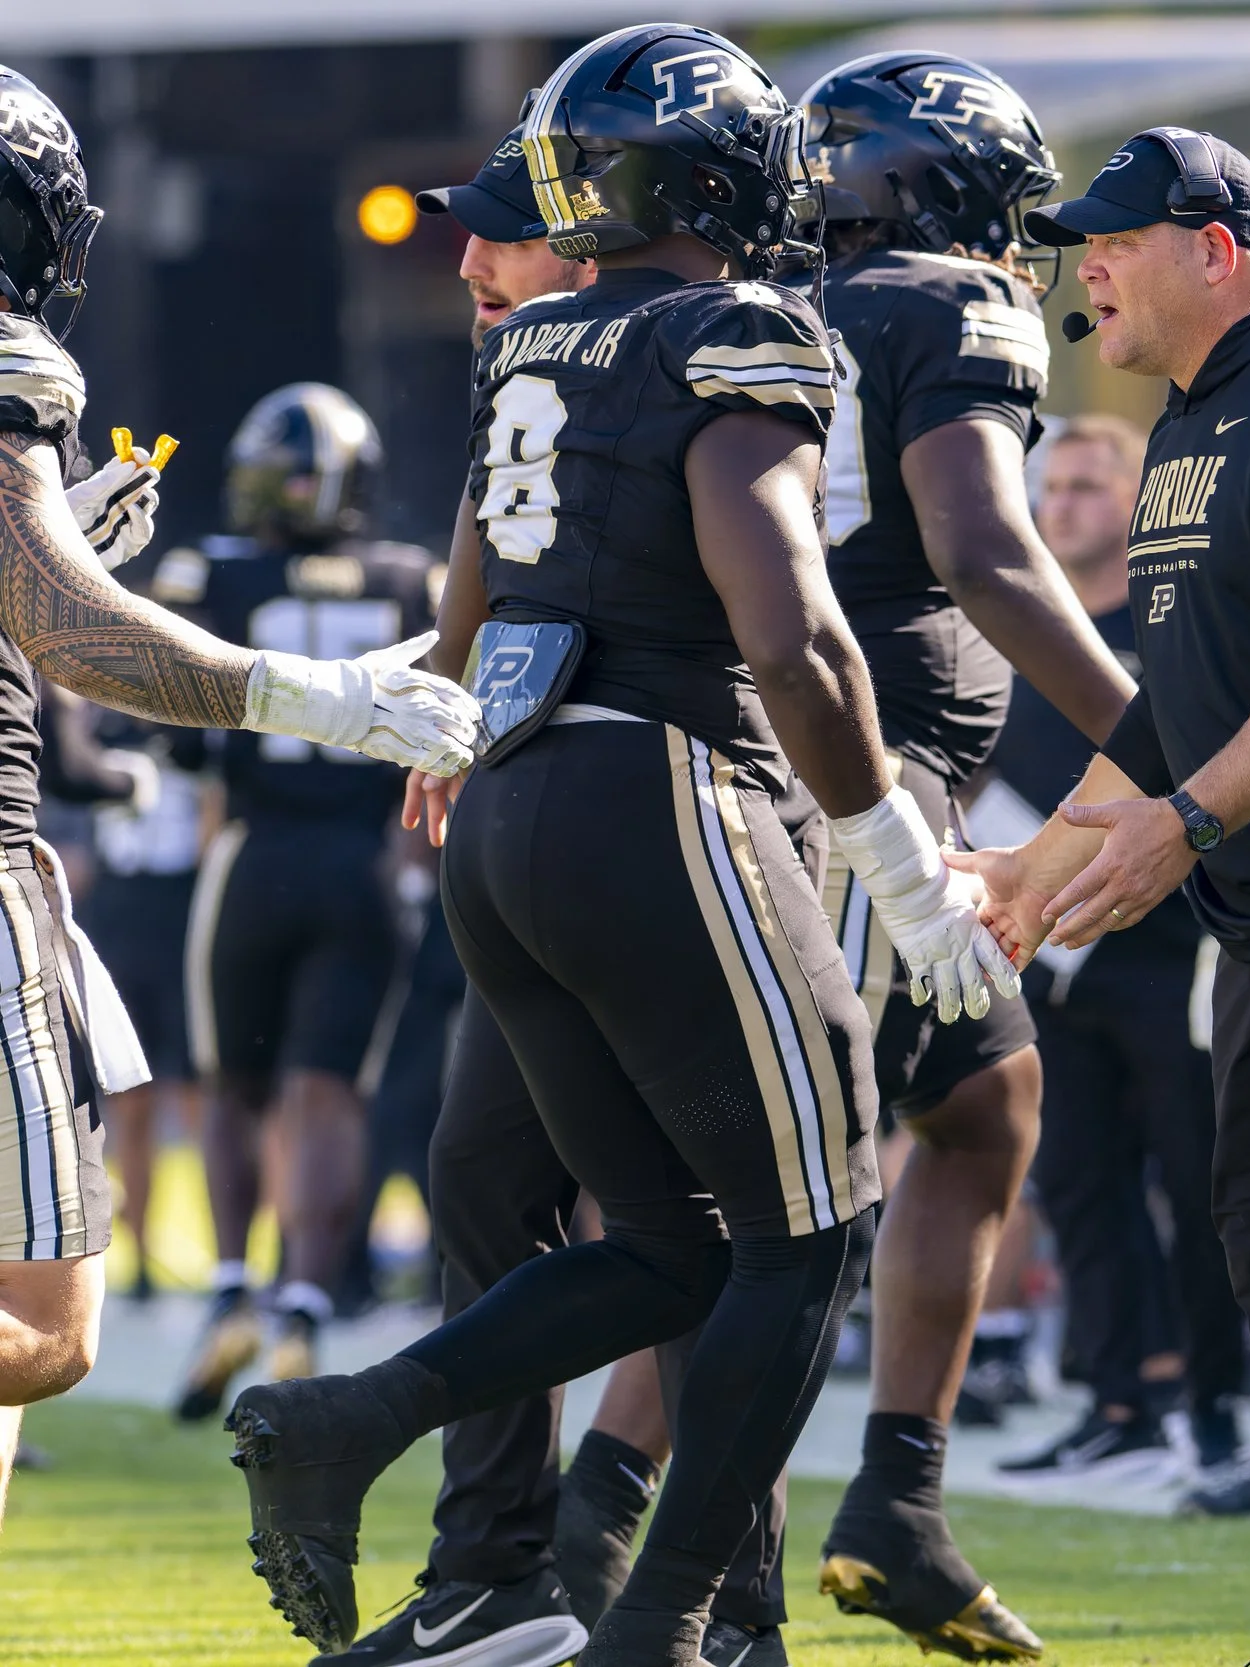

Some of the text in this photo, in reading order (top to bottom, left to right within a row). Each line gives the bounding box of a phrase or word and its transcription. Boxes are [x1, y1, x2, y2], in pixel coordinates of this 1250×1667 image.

[652, 49, 737, 126] P
[489, 318, 630, 381] MADDEN JR
[476, 373, 569, 565] 8
[1131, 455, 1227, 537] PURDUE
[1148, 583, 1176, 624] P
[472, 646, 534, 706] P
